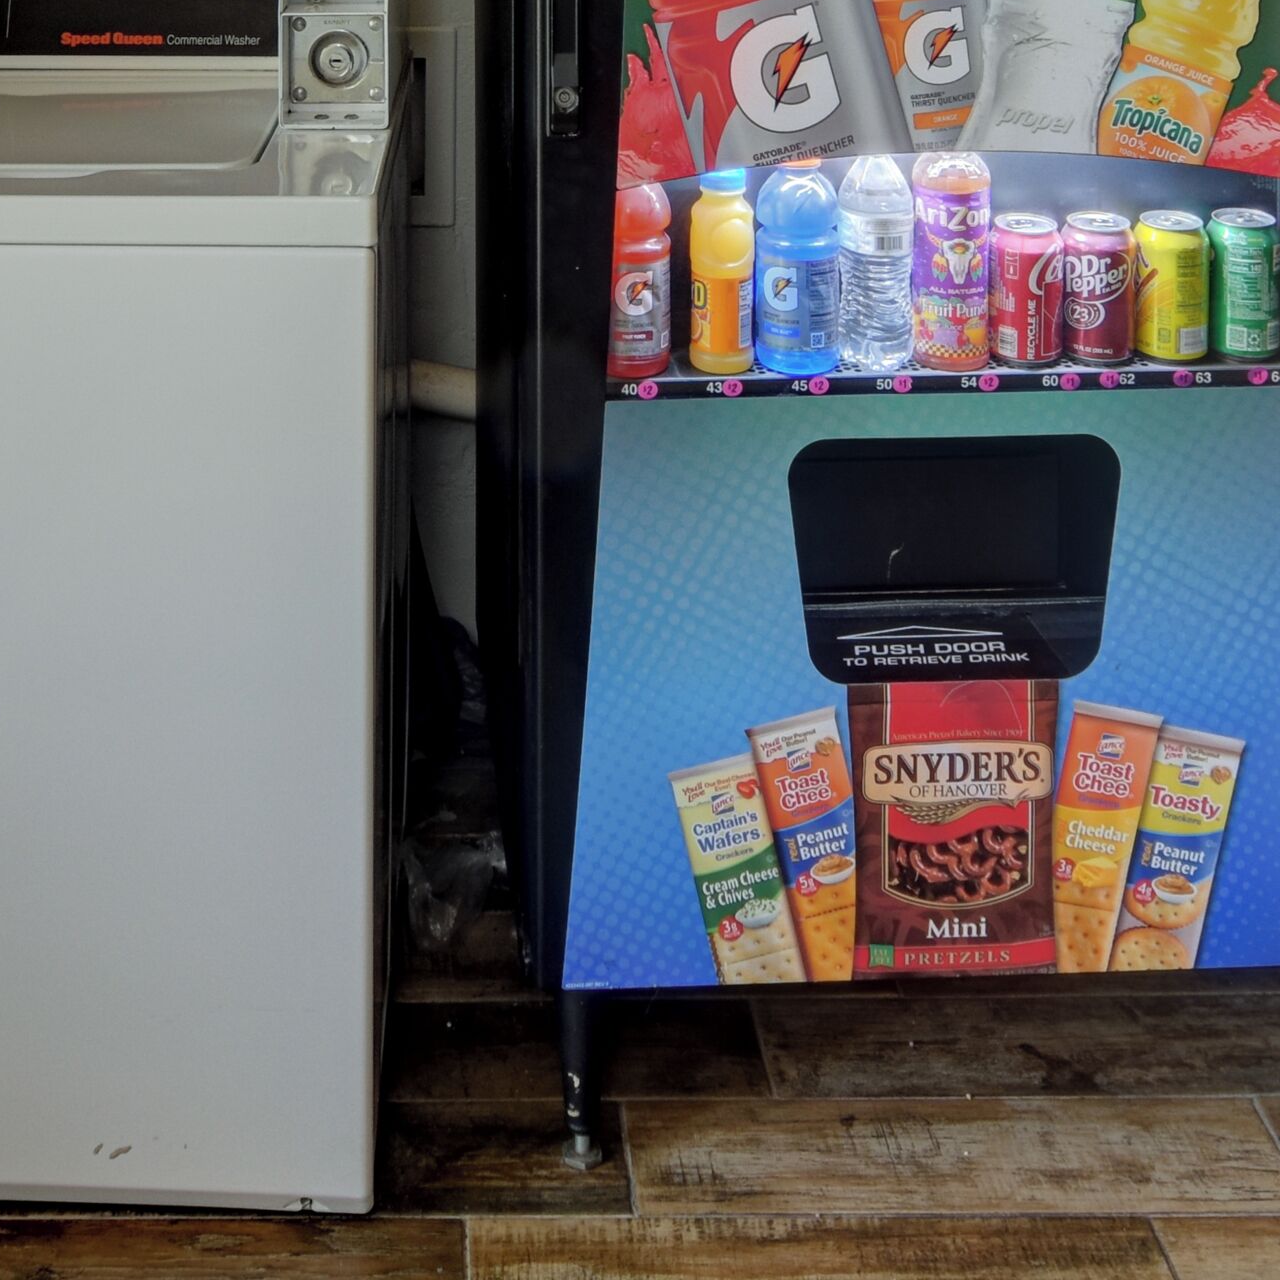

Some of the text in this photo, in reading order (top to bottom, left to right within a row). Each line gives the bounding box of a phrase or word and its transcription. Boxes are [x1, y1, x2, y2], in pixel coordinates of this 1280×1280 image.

[60, 32, 261, 47] Speed Queen Commercial Washer
[903, 6, 970, 85] G
[730, 1, 842, 134] G
[1144, 53, 1216, 86] ORANGE JUICE
[911, 92, 976, 108] THIRST QUENCHER
[995, 108, 1075, 134] propel
[1111, 99, 1204, 155] Tropicana
[752, 142, 803, 162] GATORADE
[1115, 132, 1187, 164] 100% JUICE
[1080, 254, 1111, 276] Dr
[1065, 255, 1127, 297] Pepper
[615, 271, 653, 316] G
[763, 266, 798, 311] G
[928, 286, 984, 295] ALL NATURAL
[1072, 305, 1089, 321] 23
[1027, 299, 1036, 360] RECYCLE ME
[706, 382, 722, 393] 43
[791, 380, 808, 391] 45
[876, 379, 892, 390] 50
[961, 377, 977, 387] 54
[1042, 376, 1058, 386] 60
[1120, 374, 1135, 385] 62
[1196, 373, 1212, 383] 63
[621, 383, 638, 395] 40
[854, 641, 1005, 656] PUSH DOOR
[843, 652, 1030, 667] TO RETRIEVE DRINK
[928, 730, 955, 740] Pretzel
[955, 728, 982, 738] Bakery
[982, 728, 1004, 737] Since
[1098, 737, 1125, 754] Lance
[788, 750, 811, 770] Lance
[874, 748, 1042, 786] SNYDER'S
[1077, 753, 1134, 782] Toast
[776, 769, 828, 793] Toast
[909, 783, 1008, 798] OF HANOVER
[1074, 772, 1129, 798] Chee
[688, 790, 705, 803] Love
[711, 794, 734, 814] Lance
[781, 787, 830, 810] Chee
[1151, 785, 1221, 820] Toasty
[693, 811, 758, 836] Captain's
[1162, 811, 1201, 825] Crackers
[696, 828, 761, 854] Wafers
[797, 822, 849, 846] Peanut
[1068, 820, 1129, 843] Cheddar
[715, 846, 754, 861] Crackers
[799, 839, 846, 861] Butter
[1065, 833, 1116, 855] Cheese
[1154, 841, 1205, 864] Peanut
[1058, 860, 1072, 874] 3g
[1151, 855, 1198, 875] Butter
[703, 867, 780, 896] Cream Cheese
[799, 877, 814, 888] 5g
[1137, 882, 1152, 895] 4g
[705, 888, 755, 910] & Chives
[722, 920, 738, 933] 3g
[926, 917, 988, 939] Mini
[904, 949, 1011, 966] PRETZELS
